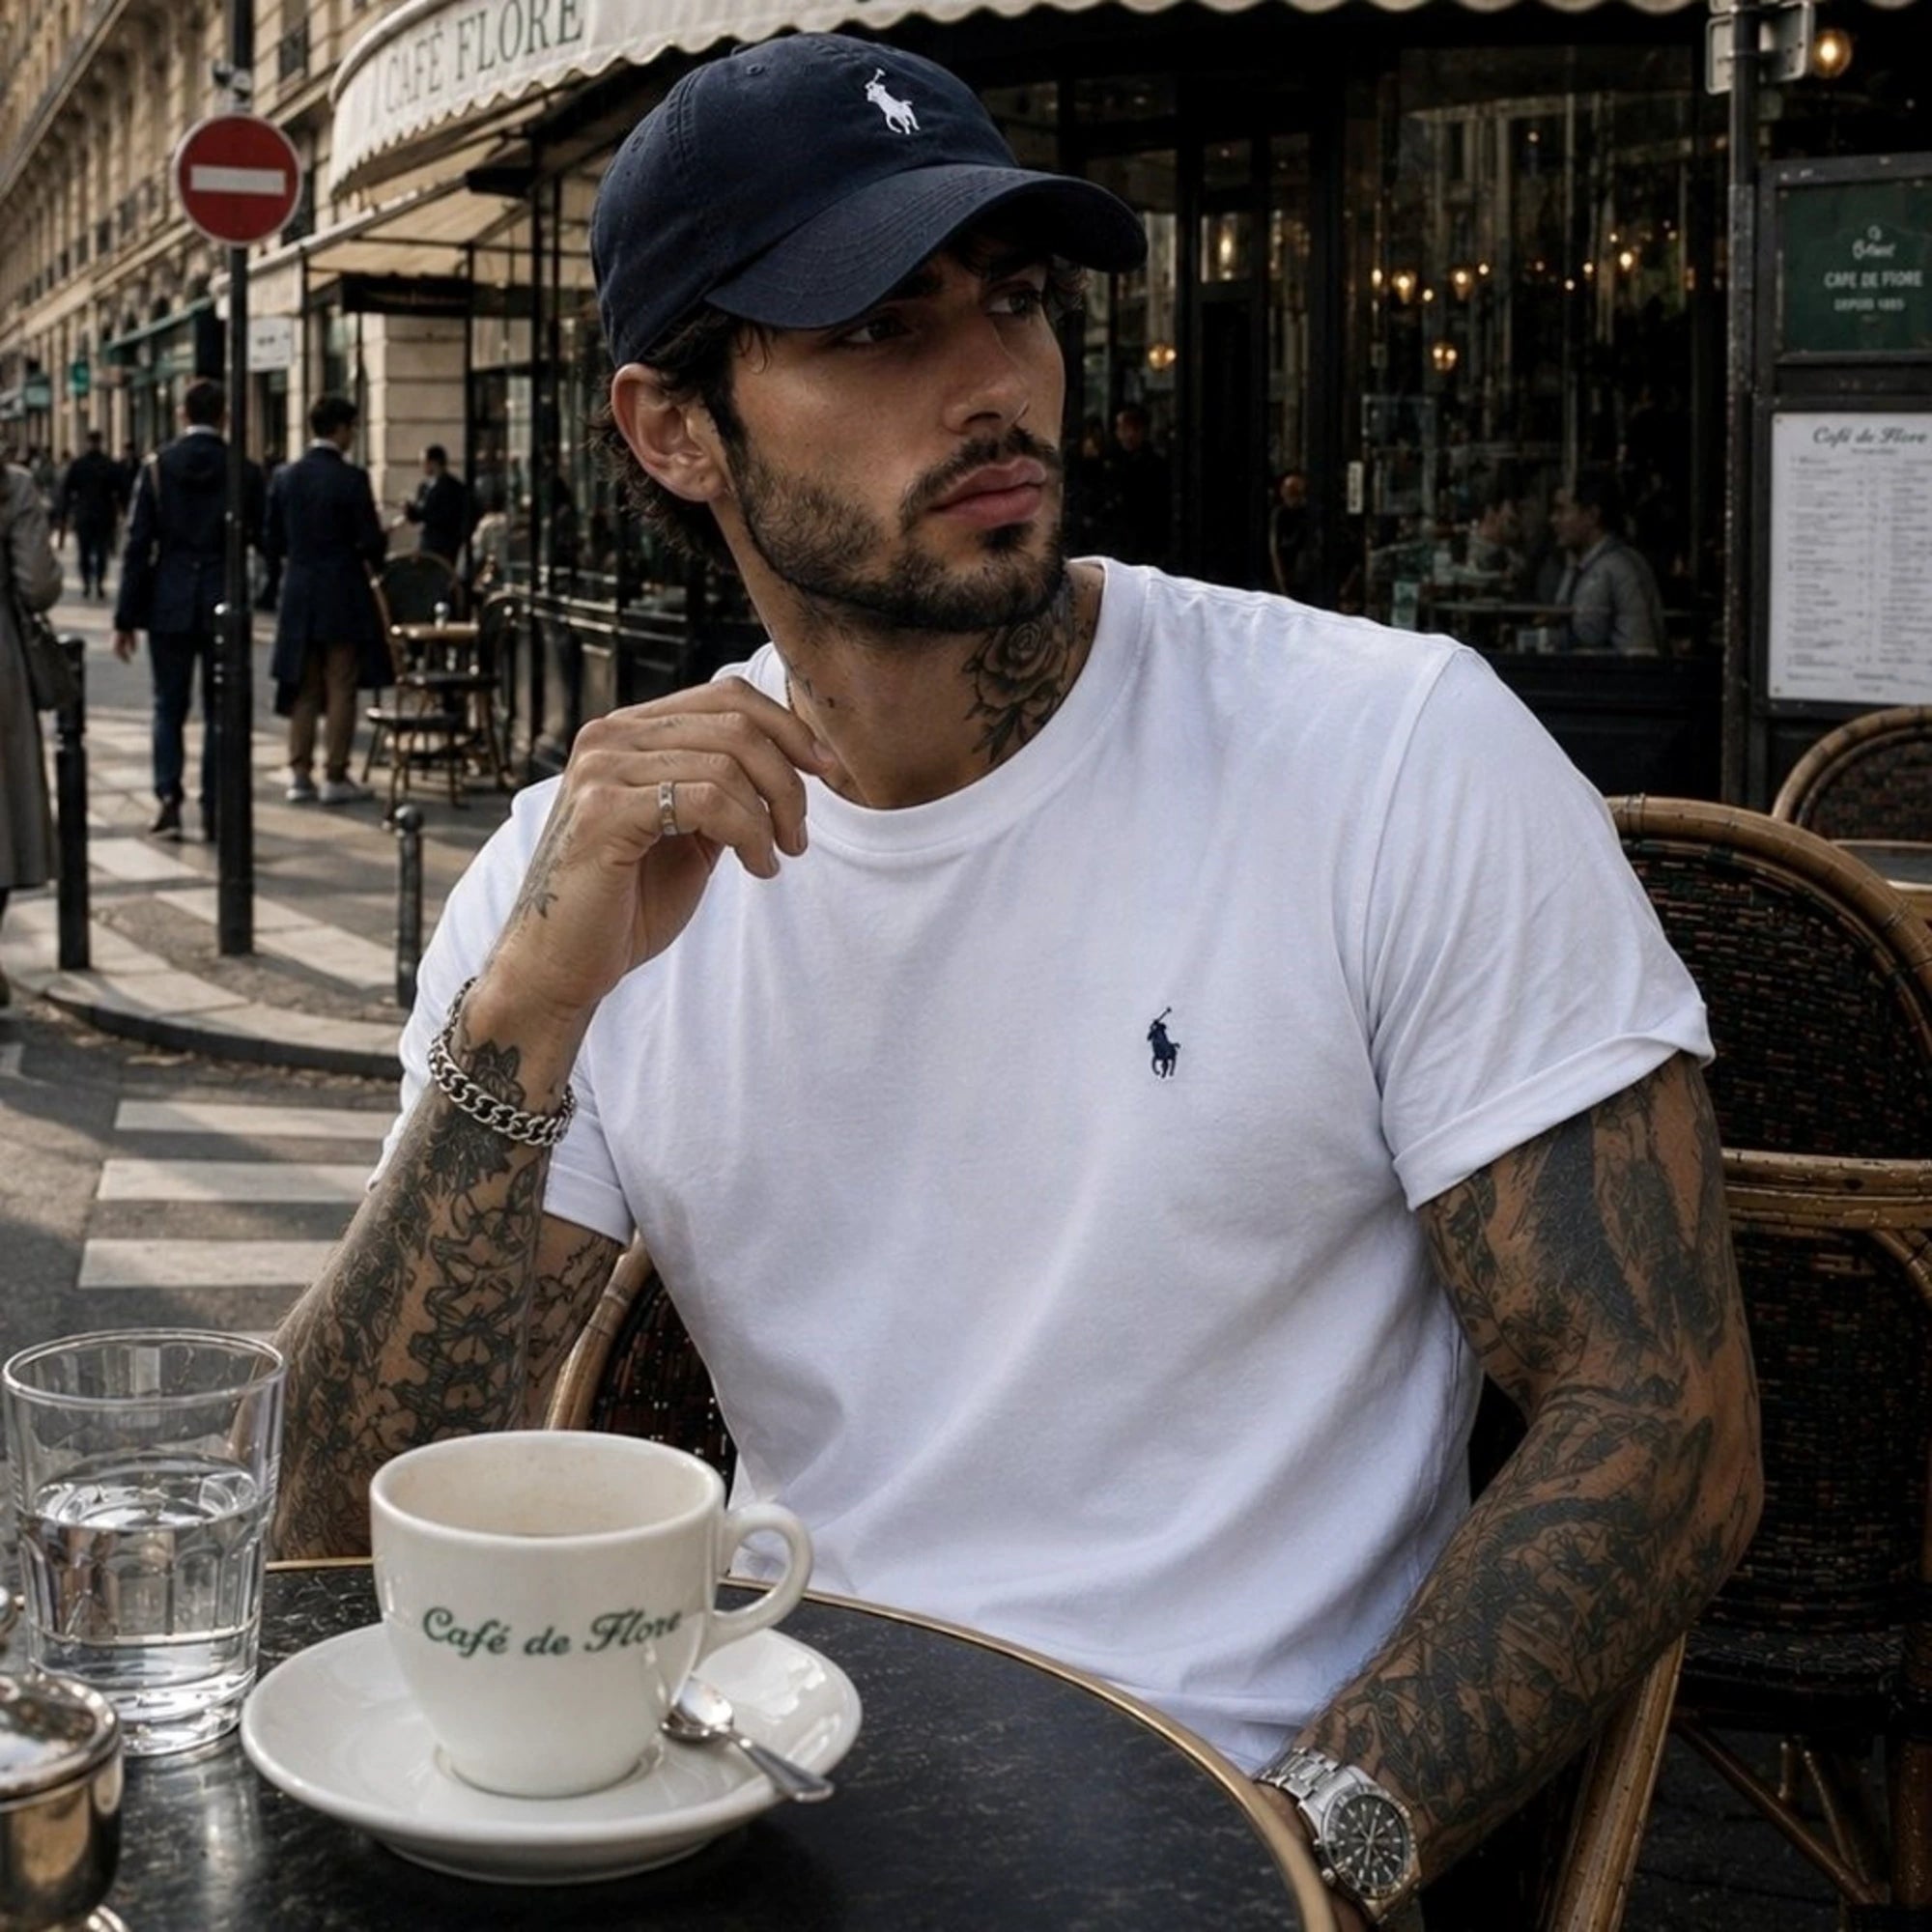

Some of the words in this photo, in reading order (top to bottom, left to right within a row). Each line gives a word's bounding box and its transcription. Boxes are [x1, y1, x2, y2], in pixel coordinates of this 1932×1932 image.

[456, 0, 584, 81] FLORE
[422, 1606, 512, 1658] Café
[523, 1626, 572, 1656] de
